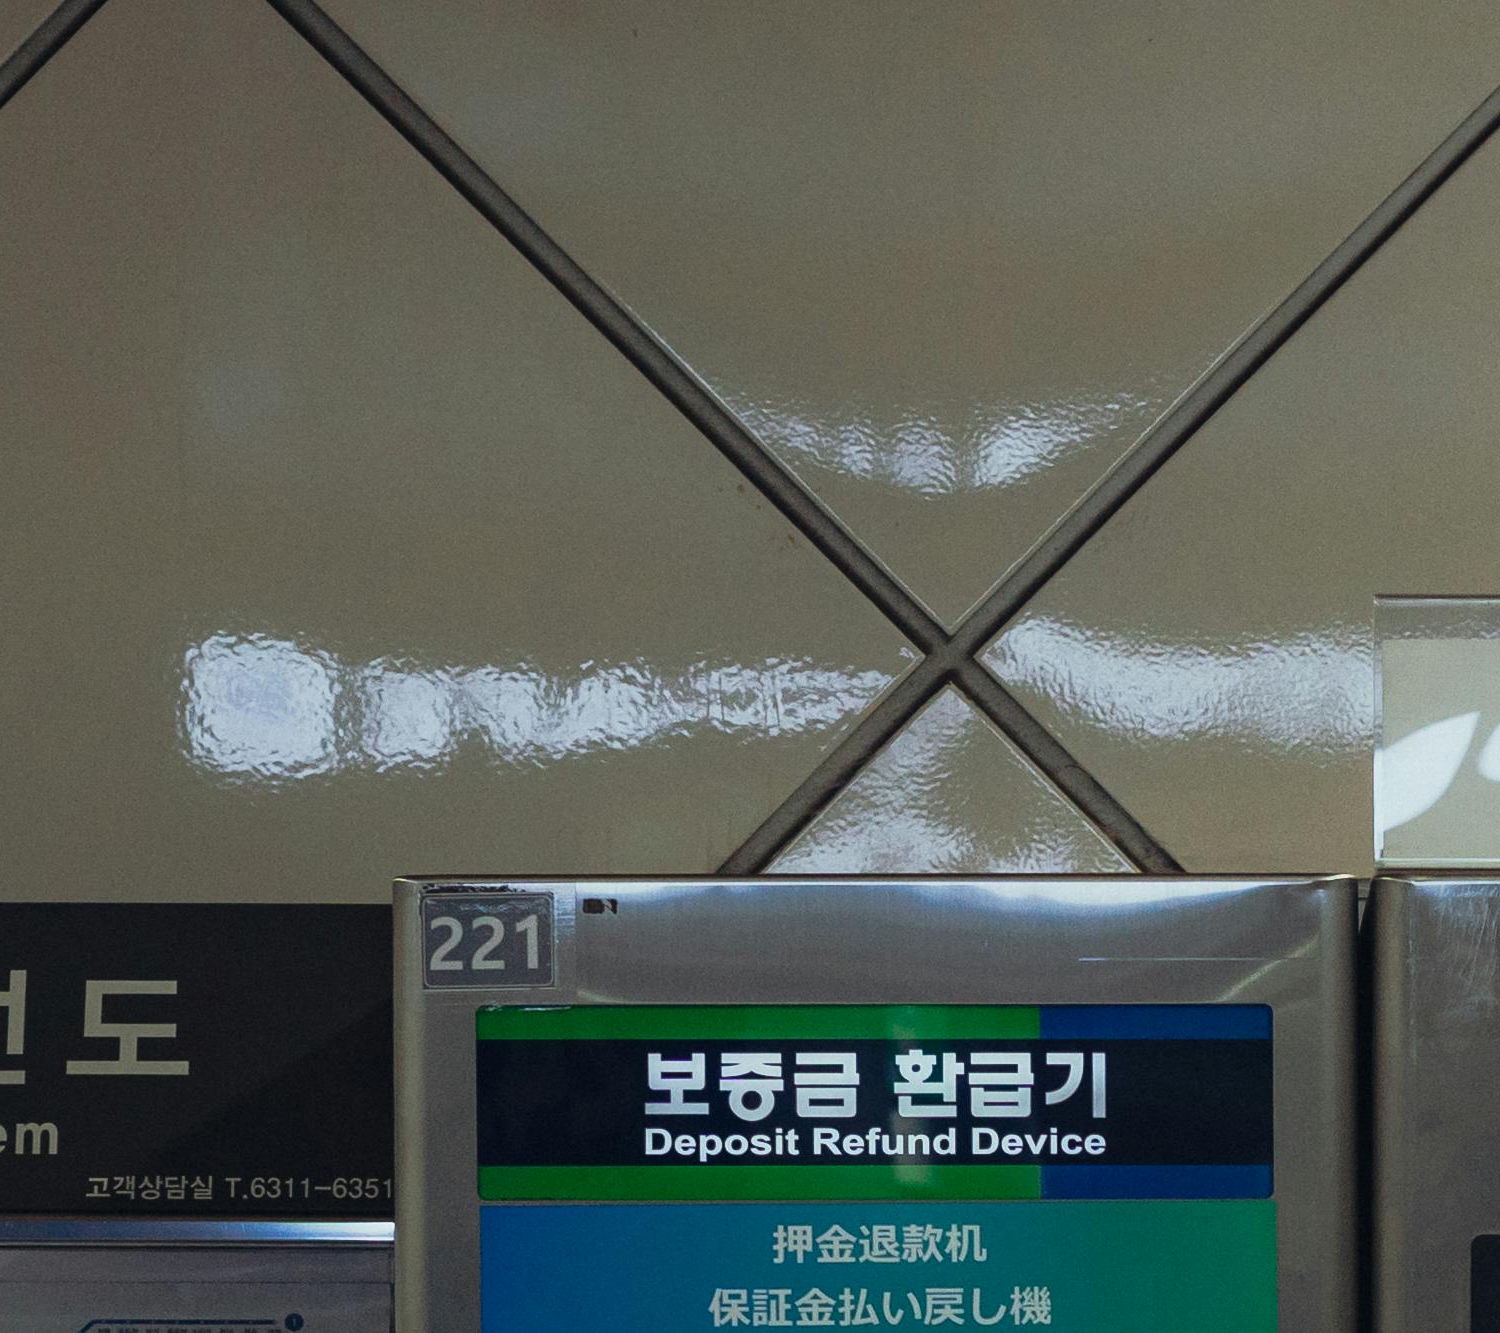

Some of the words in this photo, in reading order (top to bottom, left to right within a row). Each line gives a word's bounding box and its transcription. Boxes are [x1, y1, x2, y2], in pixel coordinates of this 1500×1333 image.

[429, 913, 539, 971] 221
[645, 1052, 860, 1122] 보증금
[893, 1048, 1106, 1119] 환급기
[644, 1127, 800, 1163] Deposit
[812, 1126, 957, 1156] Refund
[971, 1127, 1107, 1156] Device
[85, 1175, 214, 1200] 고객상담실
[224, 1177, 392, 1199] T.6311-6351
[773, 1224, 987, 1264] 押金退款机
[708, 1285, 1052, 1328] 保証金払い戻し機
